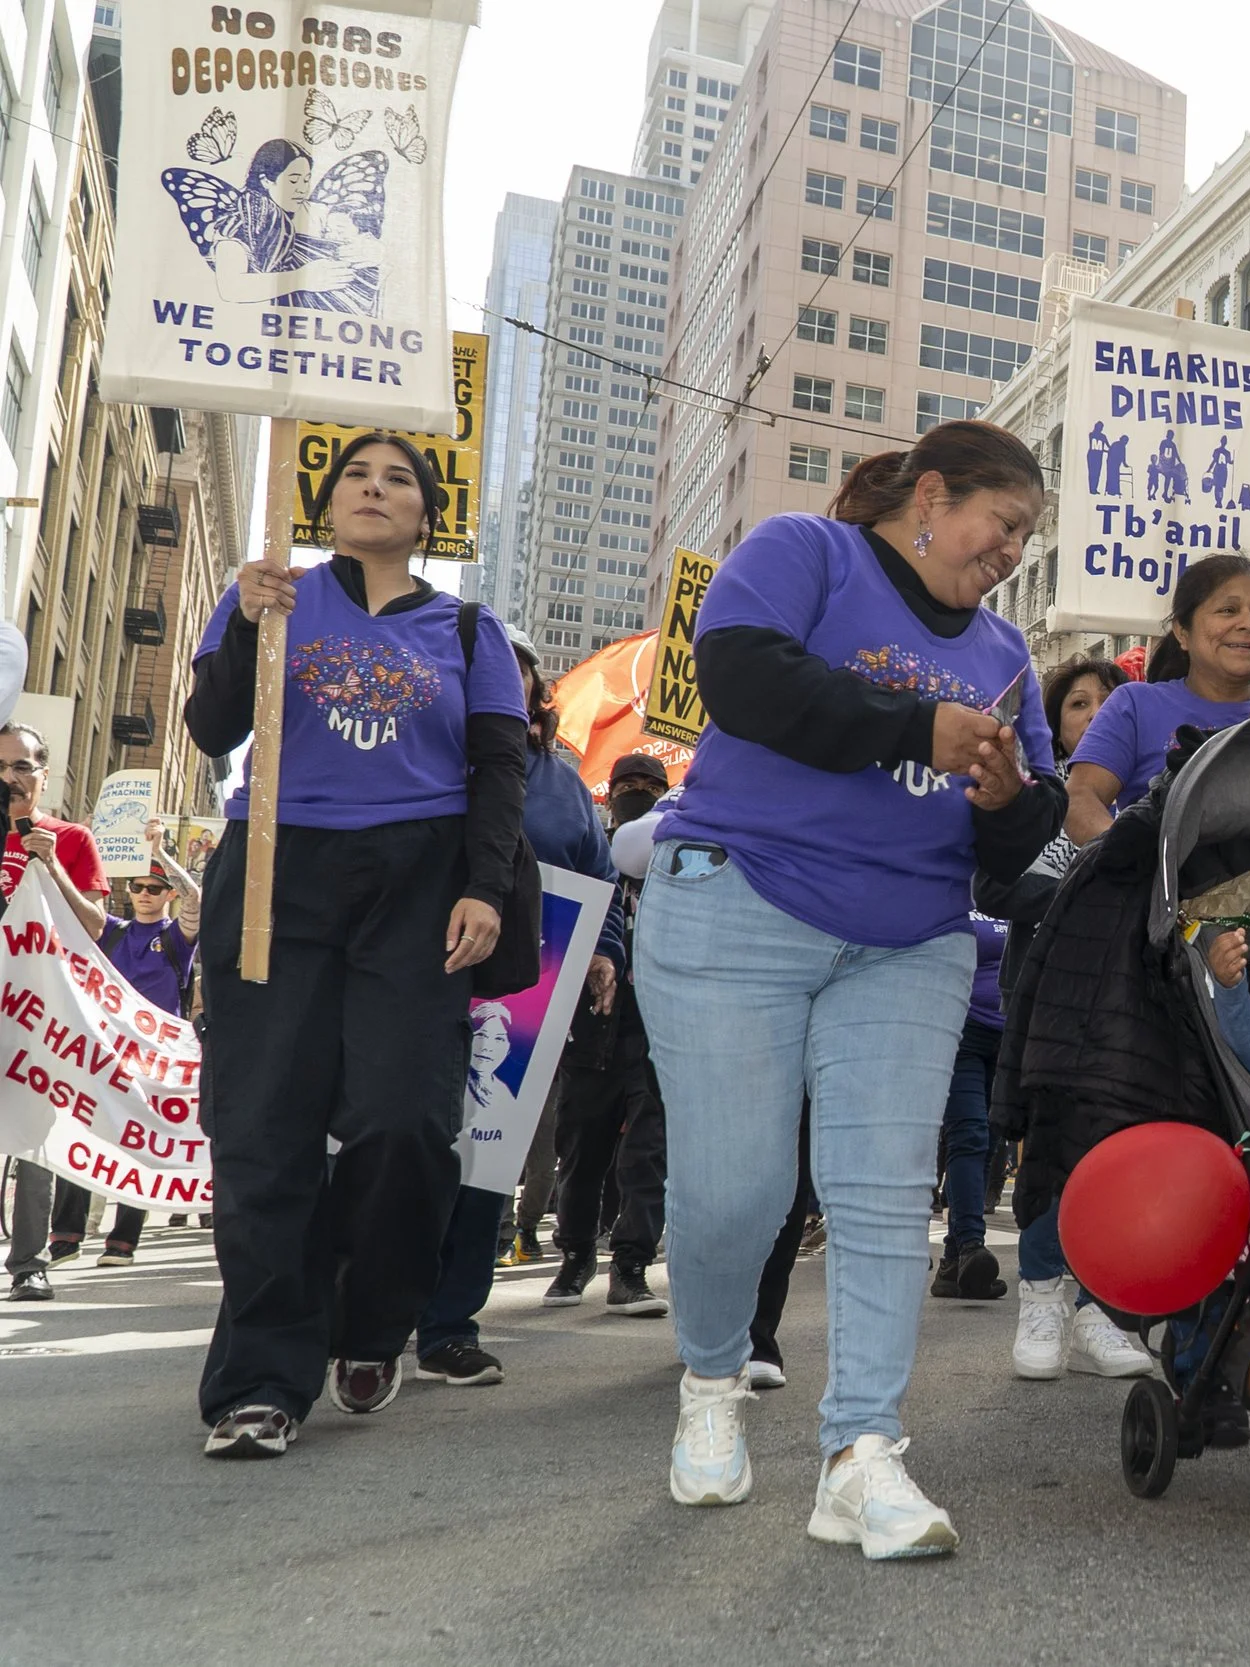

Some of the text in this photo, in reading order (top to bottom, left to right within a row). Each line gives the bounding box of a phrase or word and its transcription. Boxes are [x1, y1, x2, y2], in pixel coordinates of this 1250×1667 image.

[211, 5, 402, 58] NO MAS
[171, 47, 427, 95] DEPORTACIONES
[152, 299, 424, 354] WE BELONG
[178, 338, 403, 386] TOGETHER
[1111, 385, 1243, 430] DIGNOS
[327, 707, 398, 751] MUA
[103, 837, 141, 845] SCHOOL
[0, 981, 135, 1094] WE HAVE
[134, 1009, 182, 1044] OF
[6, 1049, 98, 1127] LOSE
[120, 1119, 205, 1163] BUT
[470, 1127, 503, 1142] MUA
